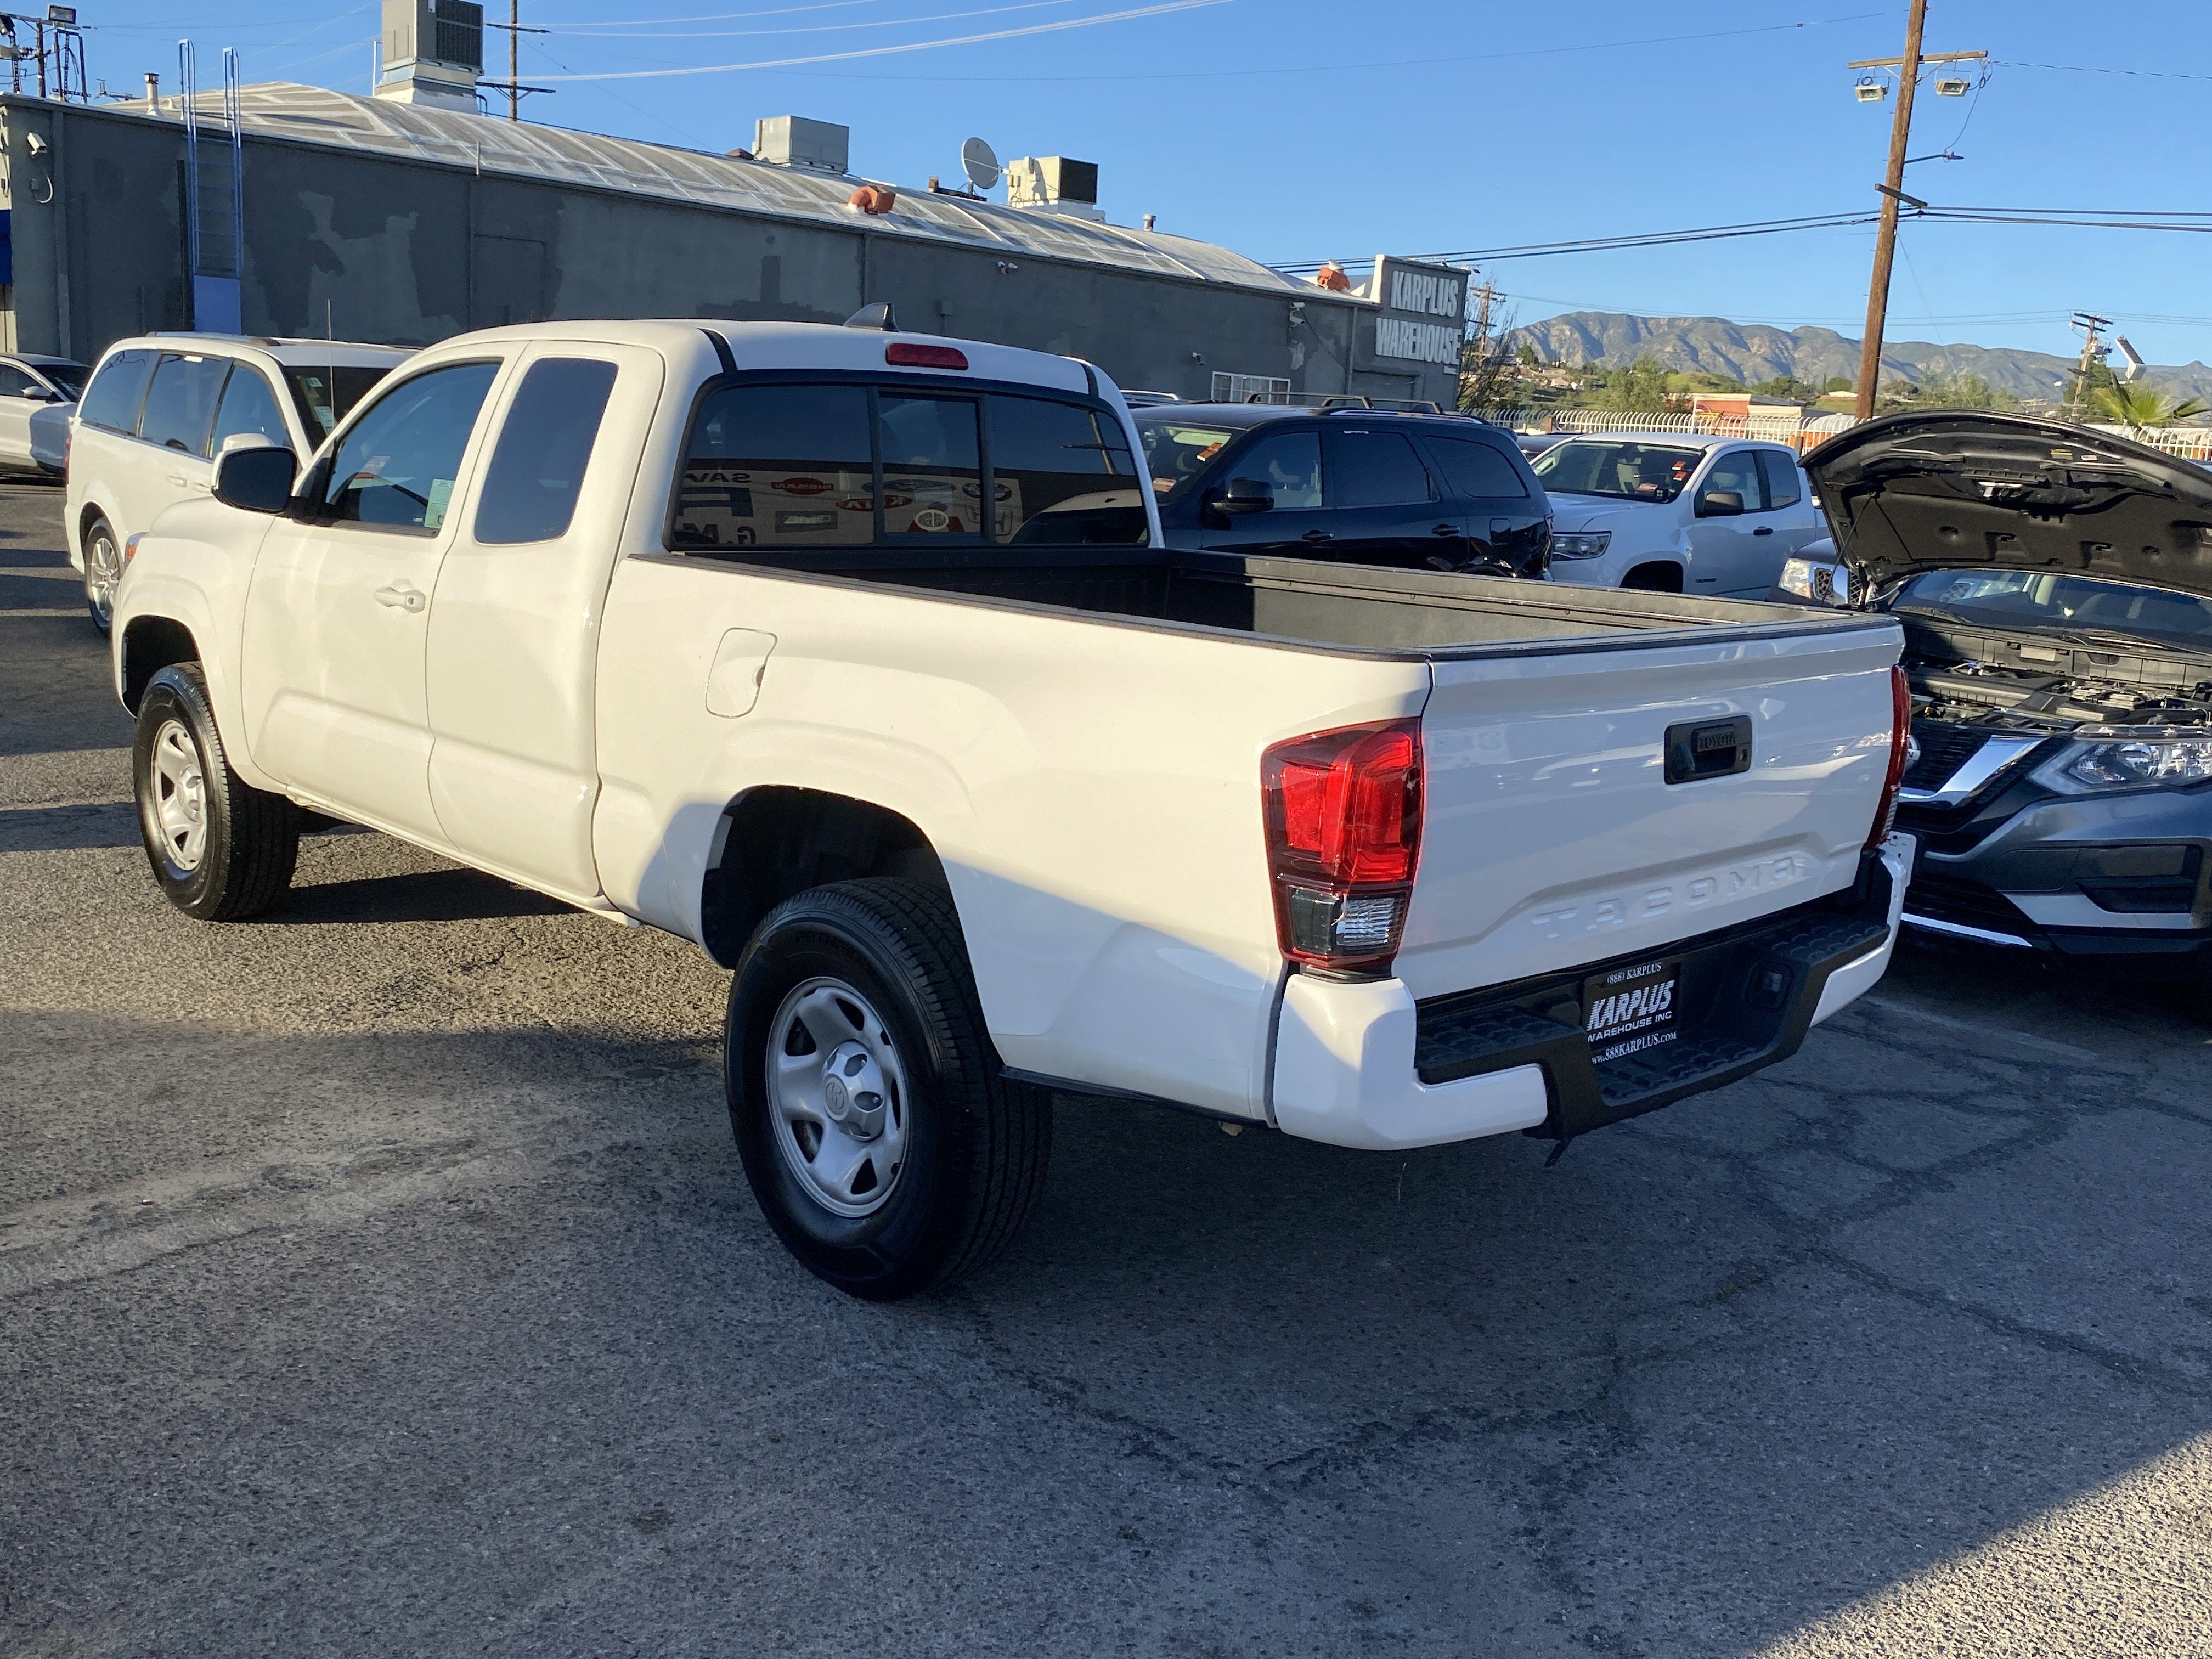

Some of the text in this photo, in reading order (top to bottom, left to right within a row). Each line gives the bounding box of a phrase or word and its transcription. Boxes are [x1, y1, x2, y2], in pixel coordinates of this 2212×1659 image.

[1390, 270, 1459, 317] KARPLUS
[1375, 318, 1462, 365] WAREHOUSE
[1700, 732, 1737, 749] TOYOTA
[1531, 856, 1799, 939] TACOMA
[1607, 962, 1662, 984] (888) KARPLUS
[1586, 980, 1675, 1031] KARPLUS
[1588, 1011, 1672, 1042] WAREHOUSE INC
